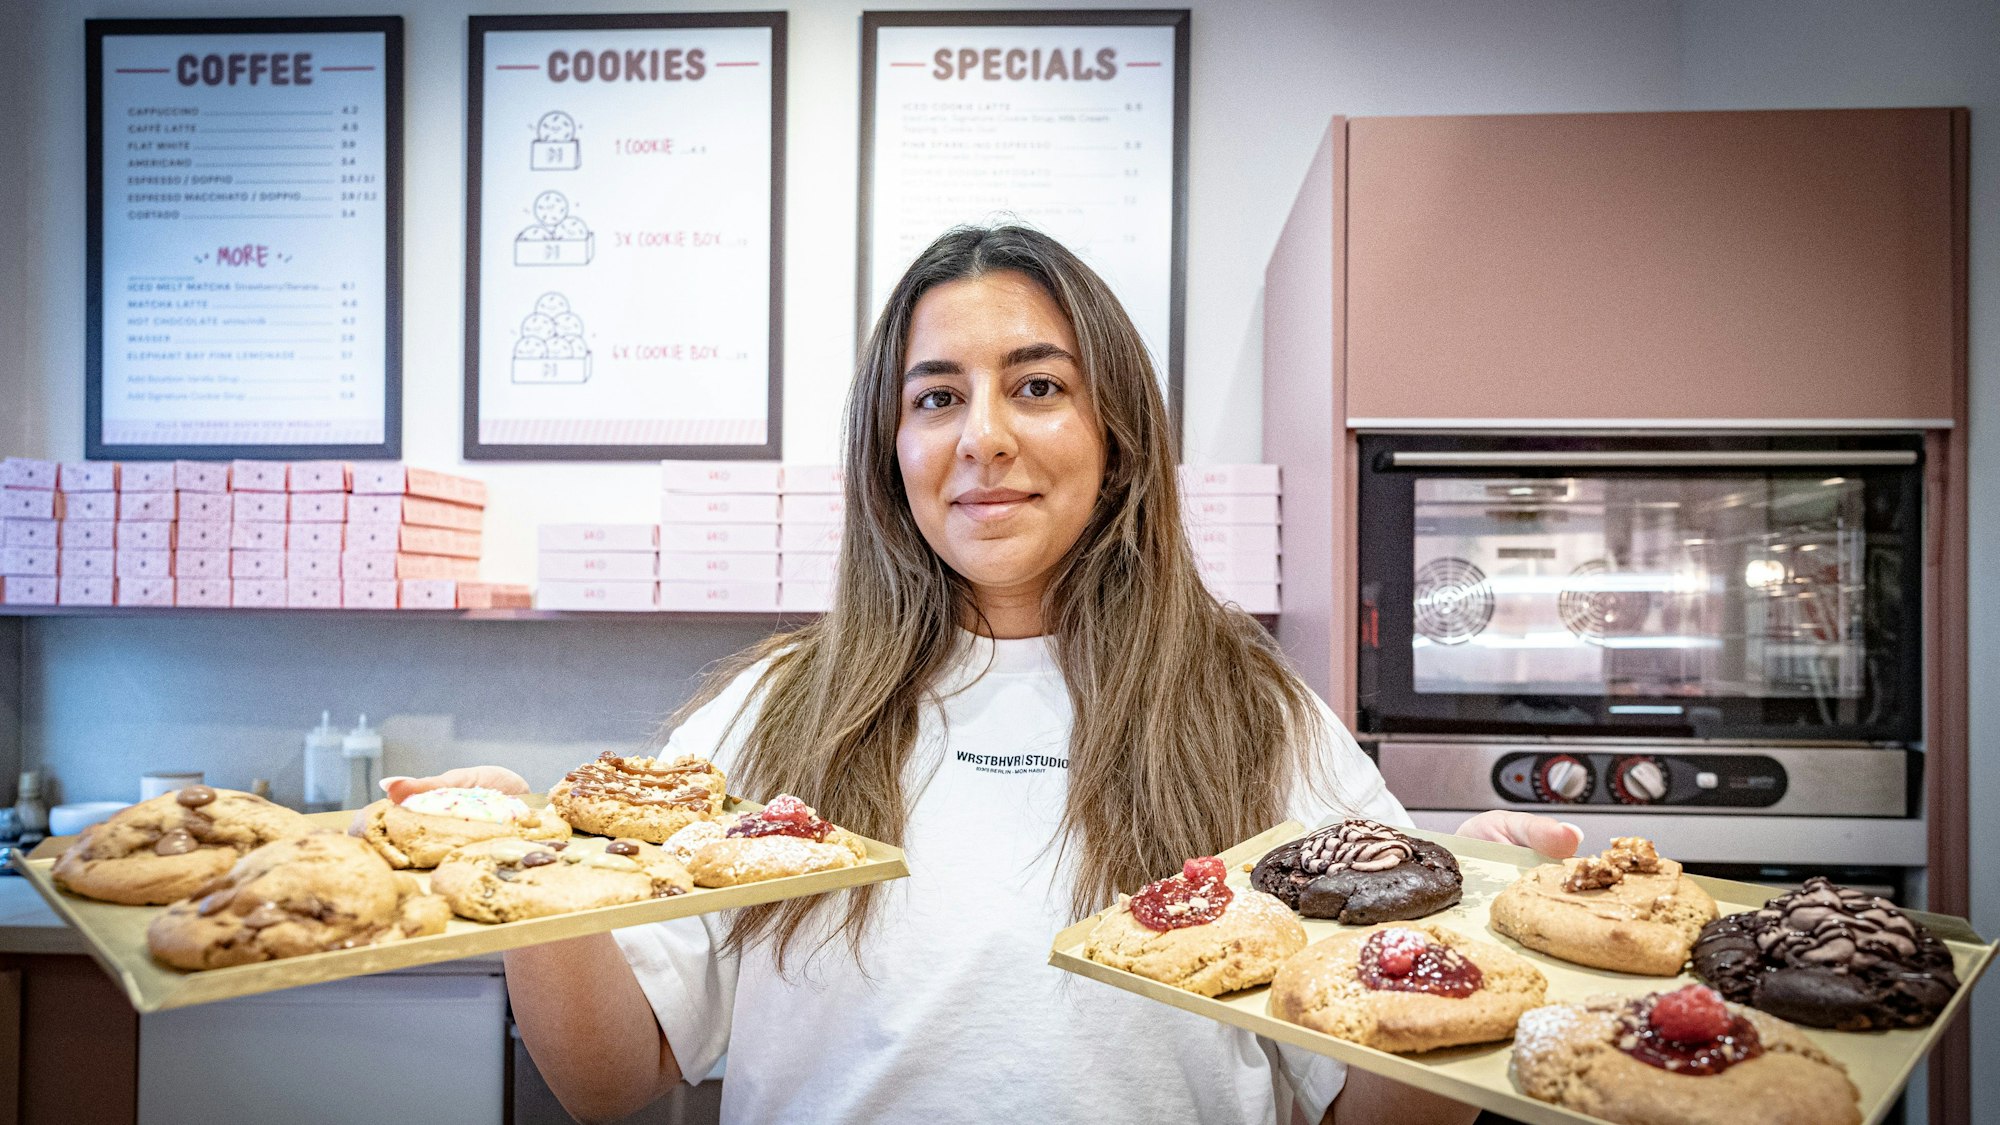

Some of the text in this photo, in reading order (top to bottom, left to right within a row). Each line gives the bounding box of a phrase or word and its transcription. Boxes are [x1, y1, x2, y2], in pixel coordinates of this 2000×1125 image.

[176, 53, 313, 86] COFFEE
[547, 48, 707, 83] COOKIES
[932, 47, 1118, 81] SPECIALS
[127, 107, 199, 118] CAPPUCCINO
[164, 124, 197, 134] LATTE
[127, 141, 153, 151] FLAT
[156, 141, 190, 151] WHITE
[624, 137, 675, 155] COOKIE
[127, 158, 192, 168] AMERICANO
[127, 175, 182, 185] ESPRESSO
[191, 175, 234, 185] DOPPIO
[127, 192, 182, 202] ESPRESSO
[184, 192, 250, 202] MACCHIATO
[259, 191, 302, 201] DOPPIO
[127, 210, 181, 220] CORTADO
[637, 231, 686, 247] COOKIE
[692, 231, 722, 247] BOX
[216, 244, 269, 267] MORE
[186, 282, 231, 292] MATCHA
[127, 300, 172, 310] MATCHA
[176, 300, 209, 310] LATTE
[127, 317, 150, 327] HOT
[154, 317, 218, 327] CHOCOLATE
[127, 334, 172, 344] WASSER
[127, 351, 182, 361] ELEPHANT
[209, 351, 233, 361] PINK
[236, 350, 295, 361] LEMONADE
[611, 344, 631, 361] 6X
[635, 344, 685, 361] COOKIE
[690, 344, 721, 360] BOX
